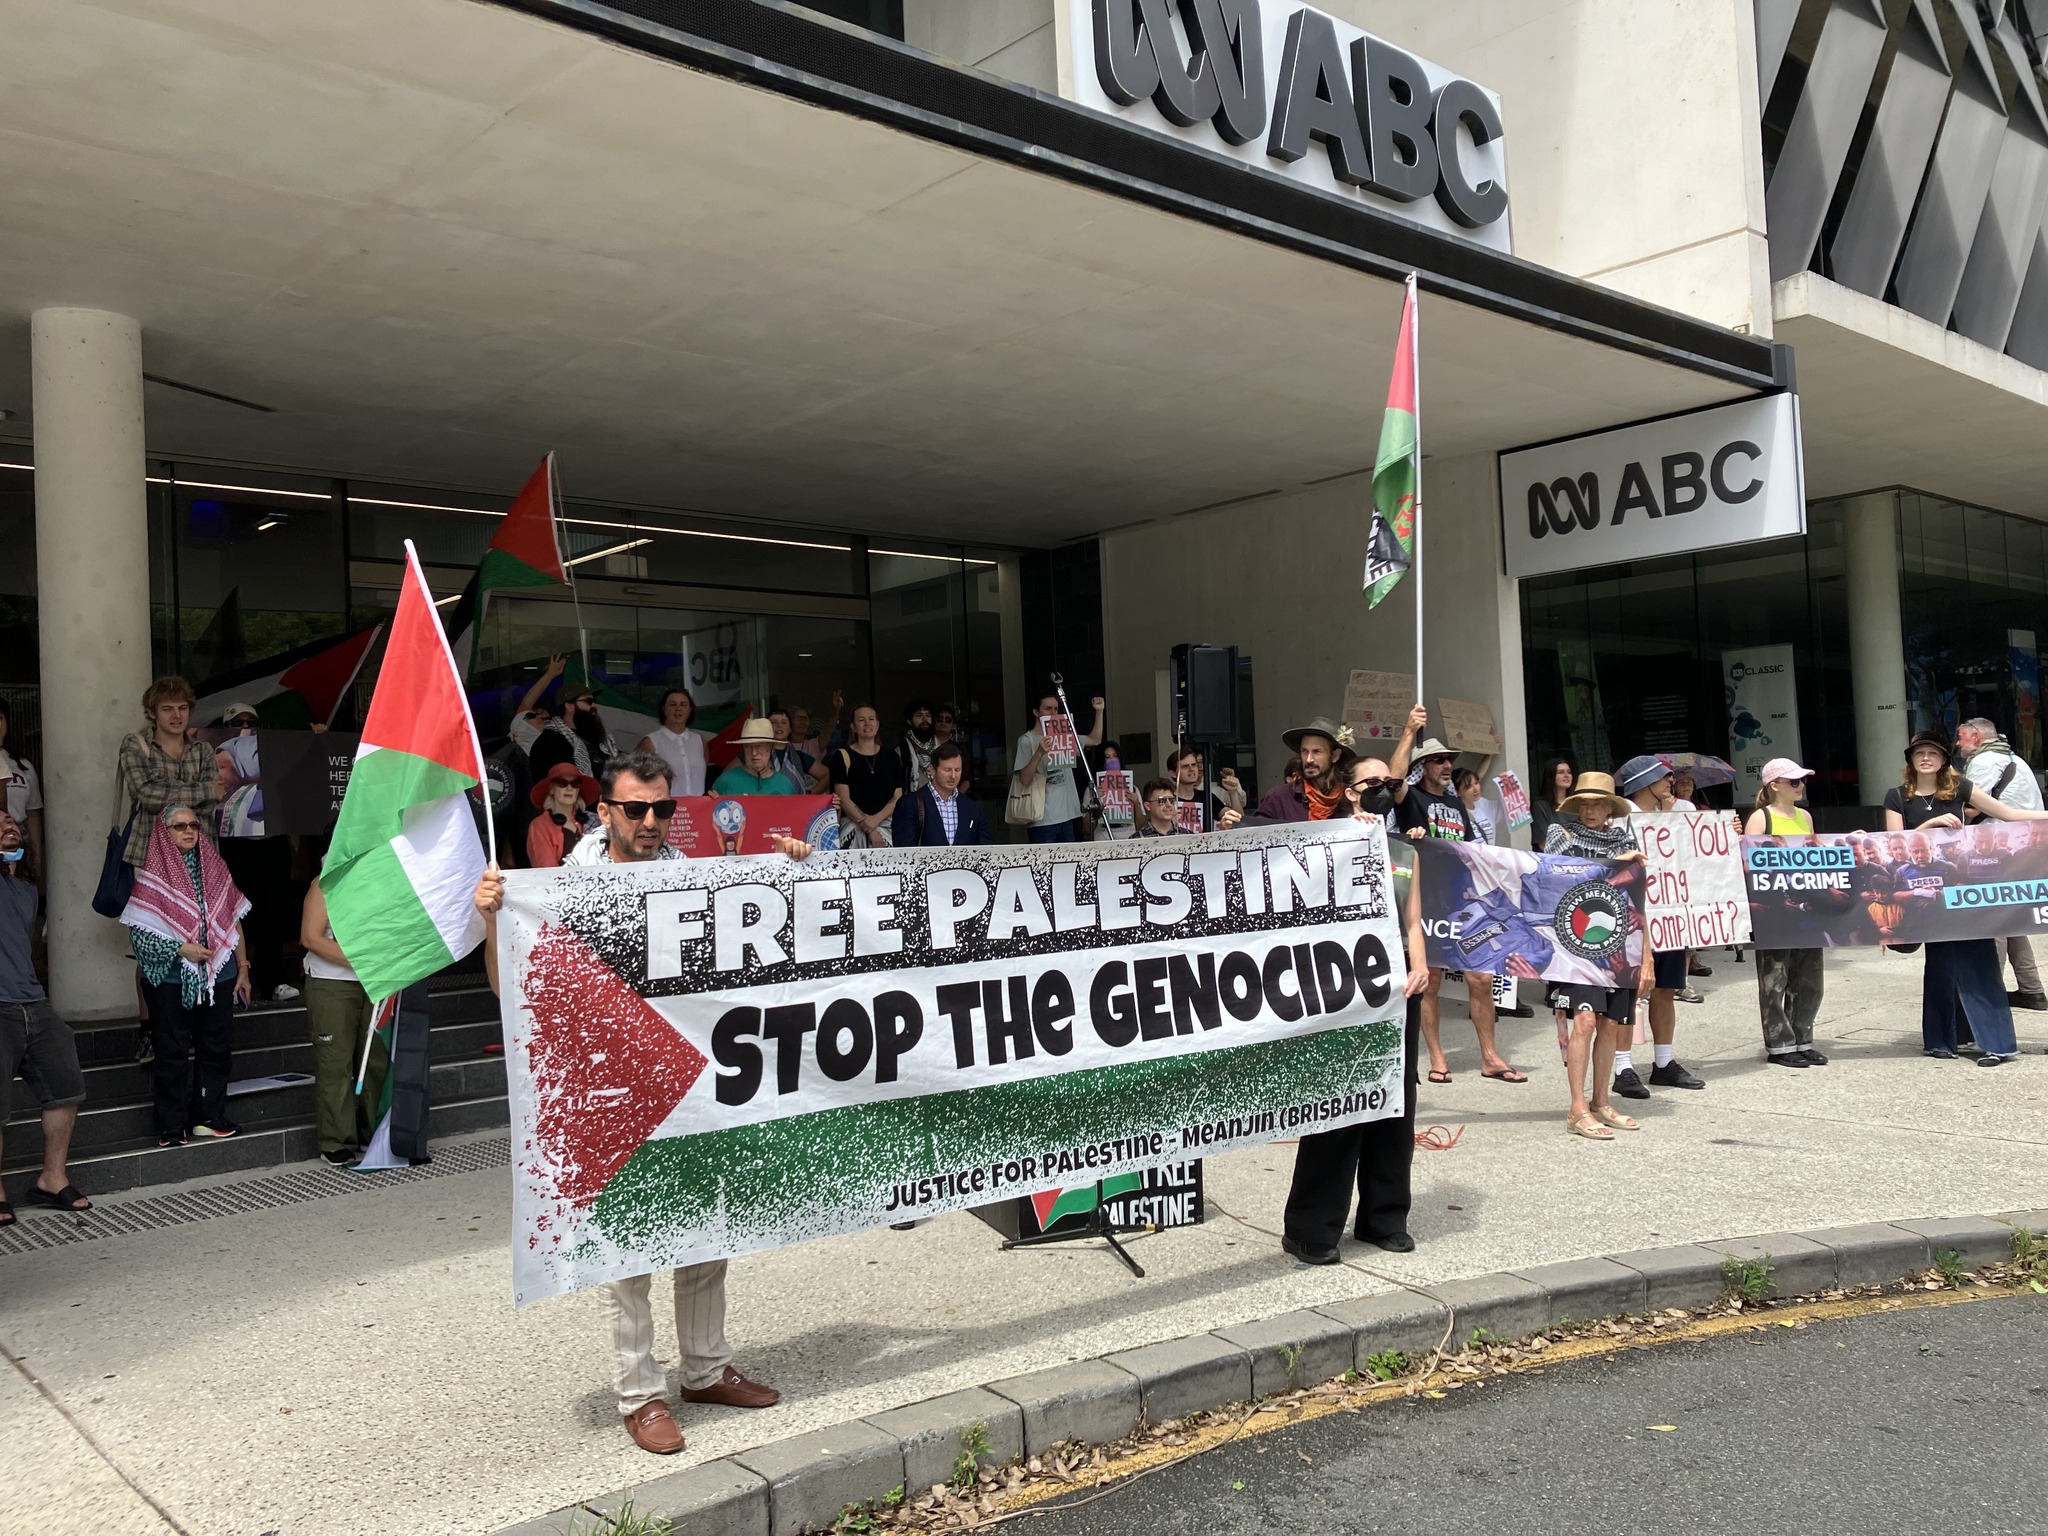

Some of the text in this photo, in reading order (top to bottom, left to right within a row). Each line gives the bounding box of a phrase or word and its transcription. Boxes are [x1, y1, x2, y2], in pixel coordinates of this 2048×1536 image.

[1267, 7, 1509, 229] ABC
[1610, 440, 1764, 526] ABC
[1745, 664, 1784, 676] CLASSIC
[328, 755, 348, 767] WE
[1048, 750, 1075, 766] STINE
[1104, 805, 1131, 820] TINE
[1504, 790, 1524, 813] PALE
[1508, 804, 1532, 828] STINE
[1437, 826, 1458, 836] WILL
[1684, 813, 1730, 857] You
[1751, 849, 1852, 868] GENOCIDE
[1646, 867, 1689, 904] eing
[1753, 872, 1851, 891] IS A CRIME
[1585, 890, 1612, 903] MEAA
[1951, 883, 2048, 907] JOURNA
[645, 838, 1372, 981] FREE PALESTINE
[1420, 918, 1463, 940] NCE
[1564, 896, 1623, 950] MEMBERS FOR PALESTINE
[1650, 900, 1738, 948] omplicit?
[1462, 930, 1492, 949] PRESS
[711, 990, 925, 1107] STOP
[992, 1157, 1037, 1188] FOR
